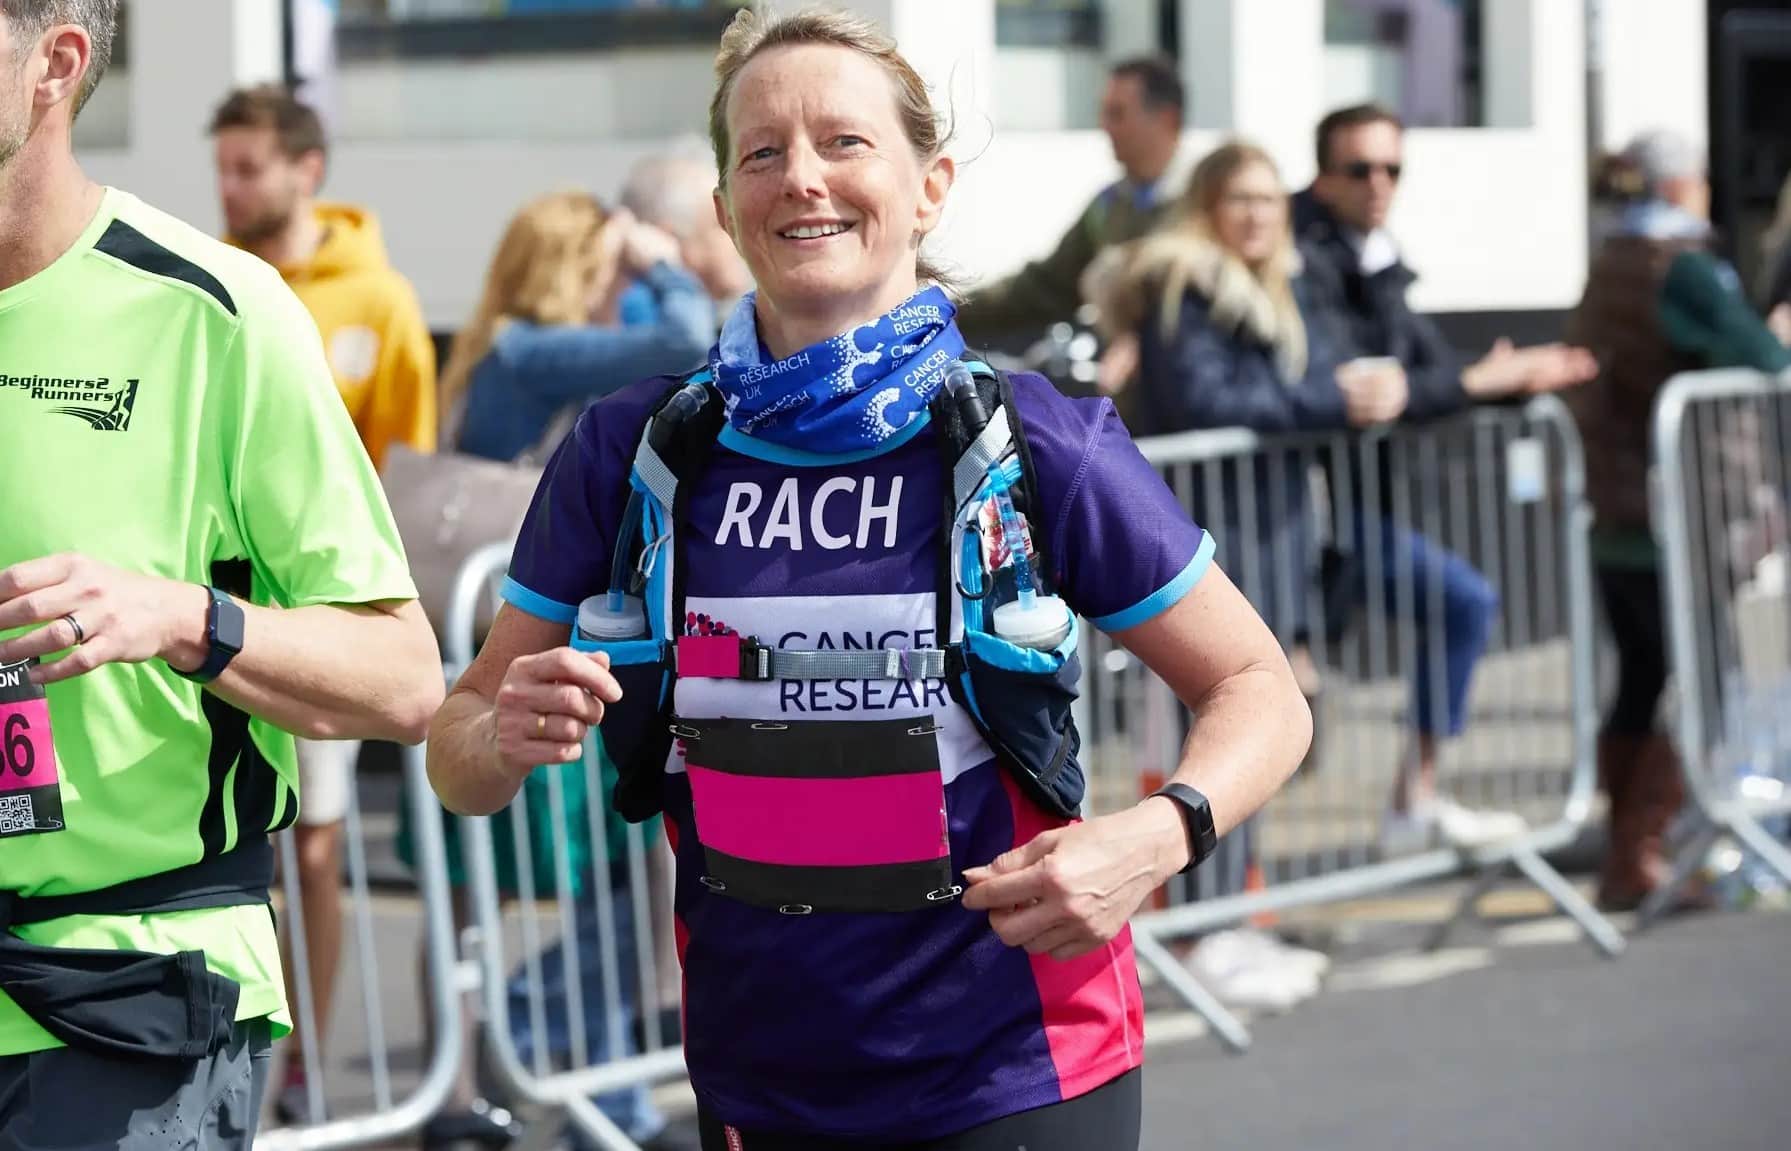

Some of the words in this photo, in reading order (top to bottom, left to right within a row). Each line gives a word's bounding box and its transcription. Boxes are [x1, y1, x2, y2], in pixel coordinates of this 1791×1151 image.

[888, 305, 940, 322] CANCER
[739, 352, 810, 387] RESEARCH
[904, 349, 949, 387] CANCER
[31, 387, 114, 402] Runners
[744, 385, 762, 400] UK
[714, 475, 904, 551] RACH
[778, 628, 935, 650] CANCE
[780, 678, 947, 712] RESEAR
[0, 713, 35, 777] 6
